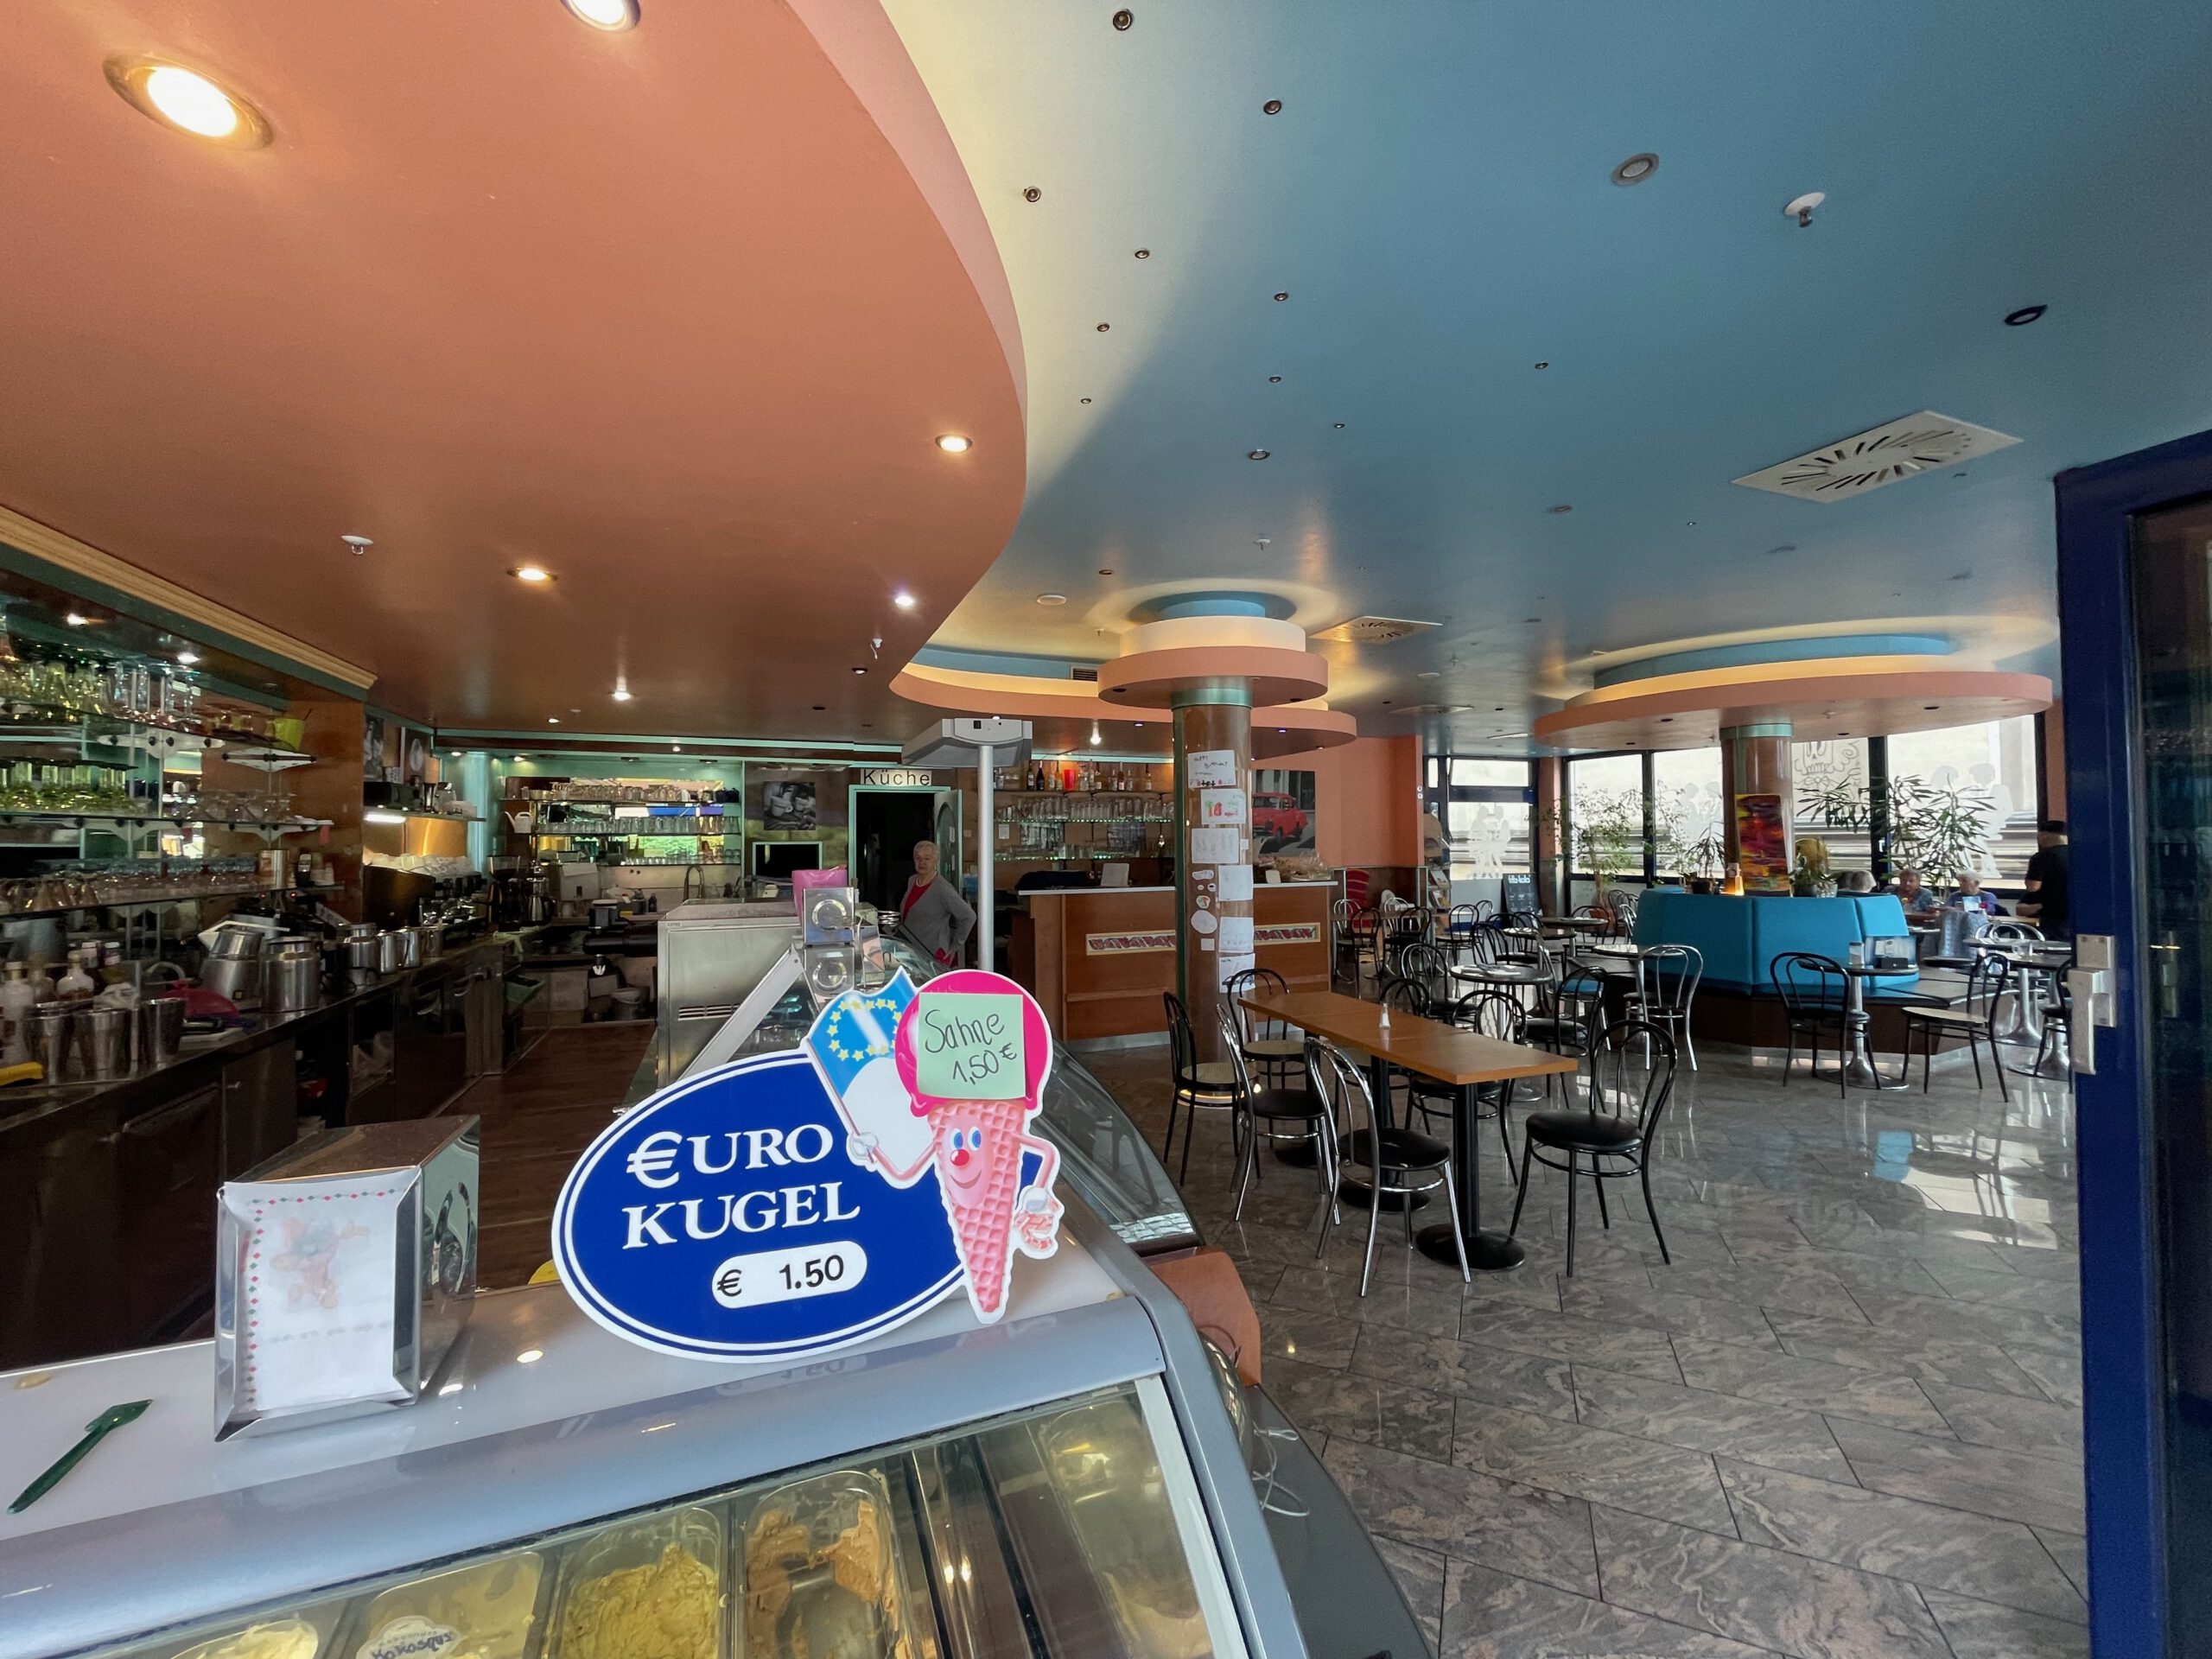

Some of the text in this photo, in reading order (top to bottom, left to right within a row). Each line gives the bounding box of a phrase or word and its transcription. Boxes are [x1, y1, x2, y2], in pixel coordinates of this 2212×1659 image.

[863, 769, 931, 786] Küche
[925, 1008, 1005, 1053] Sahne
[626, 1123, 834, 1189] €URO
[621, 1181, 861, 1250] KUGEL
[716, 1254, 845, 1298] € 1.50
